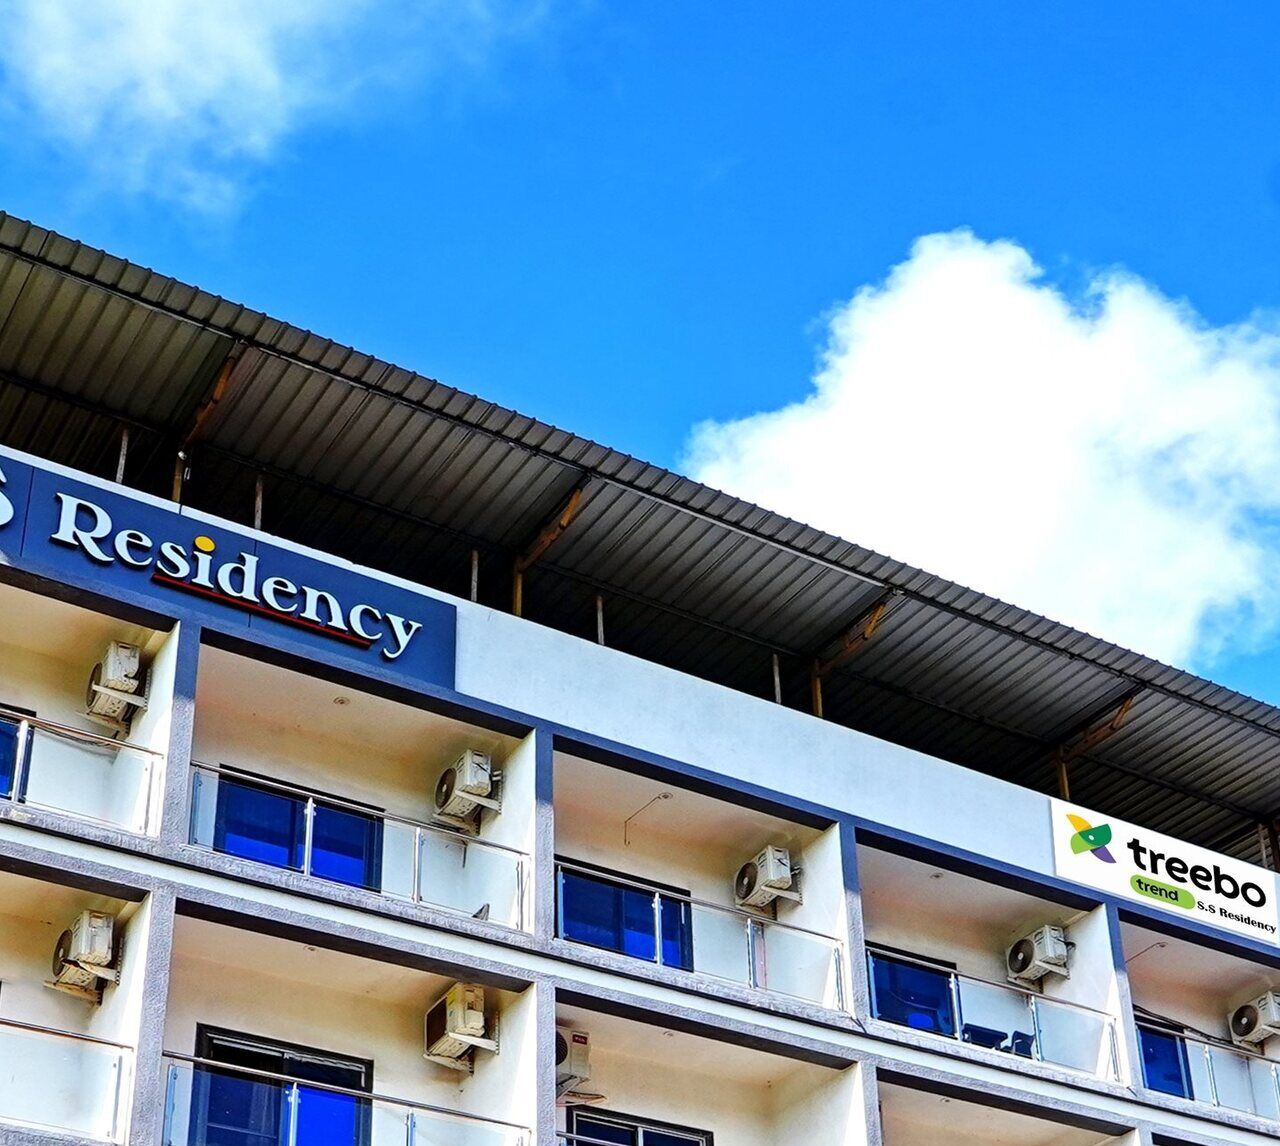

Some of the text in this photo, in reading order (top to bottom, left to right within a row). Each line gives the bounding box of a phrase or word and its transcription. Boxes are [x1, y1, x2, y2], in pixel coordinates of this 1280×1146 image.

[51, 492, 423, 658] Residency
[1127, 837, 1267, 908] treebo
[1136, 878, 1179, 902] trend
[1197, 901, 1277, 934] S.S Residency
